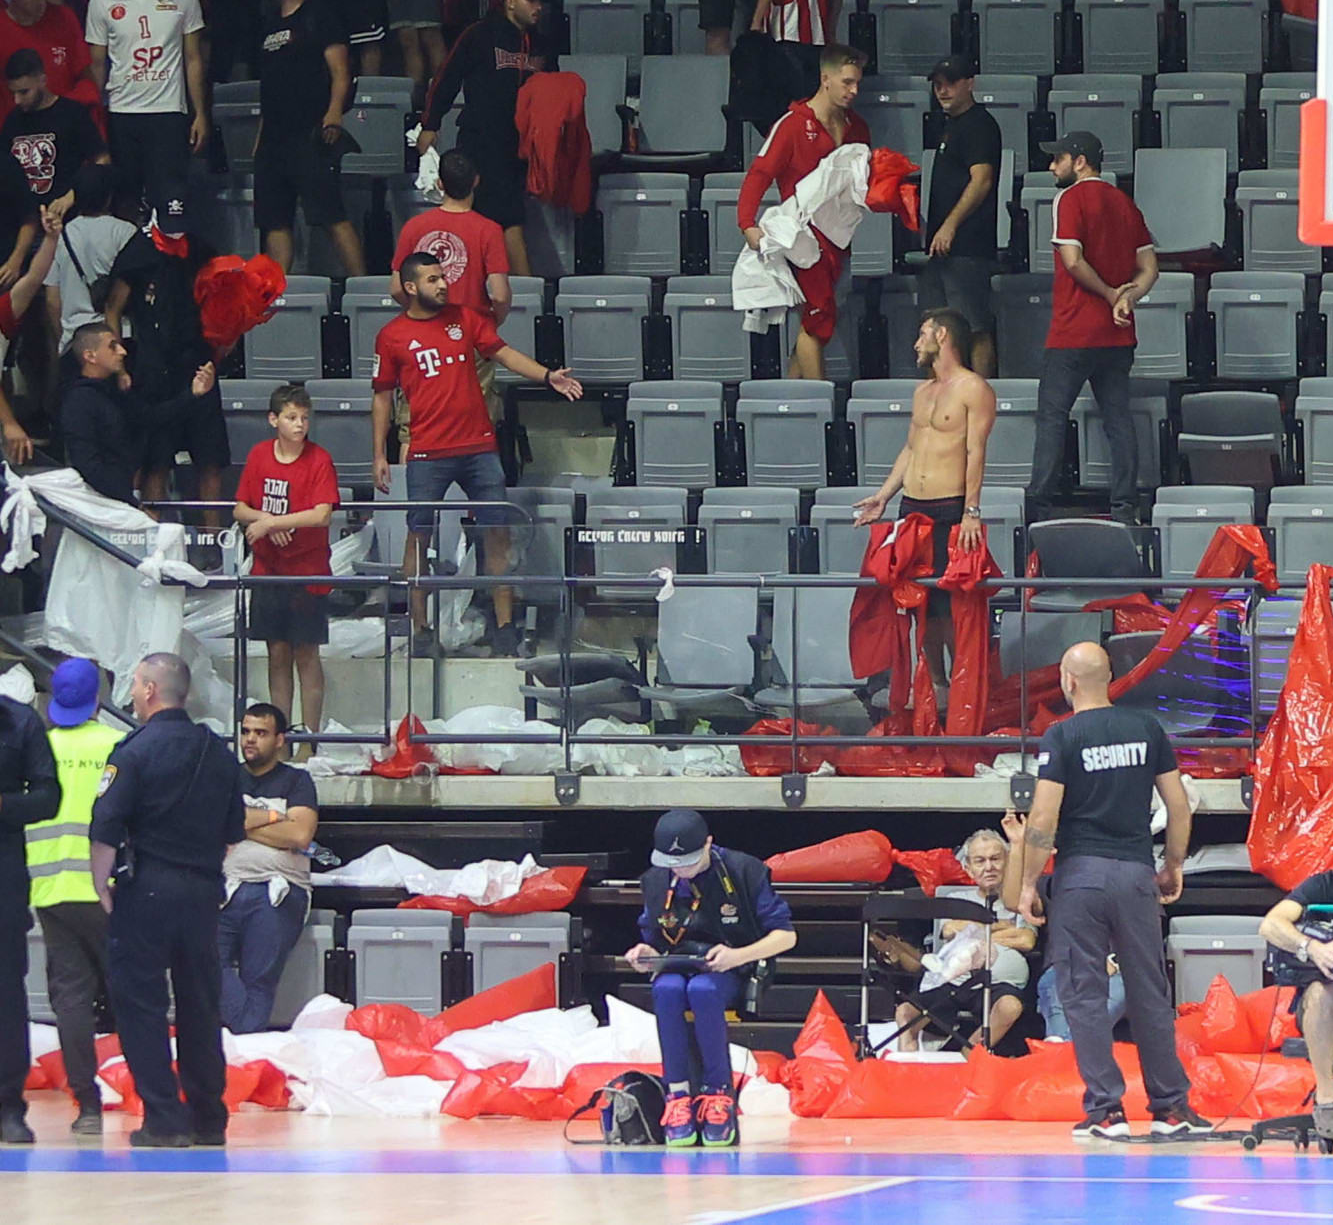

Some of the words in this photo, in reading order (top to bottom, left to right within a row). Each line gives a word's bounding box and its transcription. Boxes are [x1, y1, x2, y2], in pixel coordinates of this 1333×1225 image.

[138, 15, 151, 40] 1
[131, 45, 163, 71] SP
[1081, 741, 1148, 772] SECURITY
